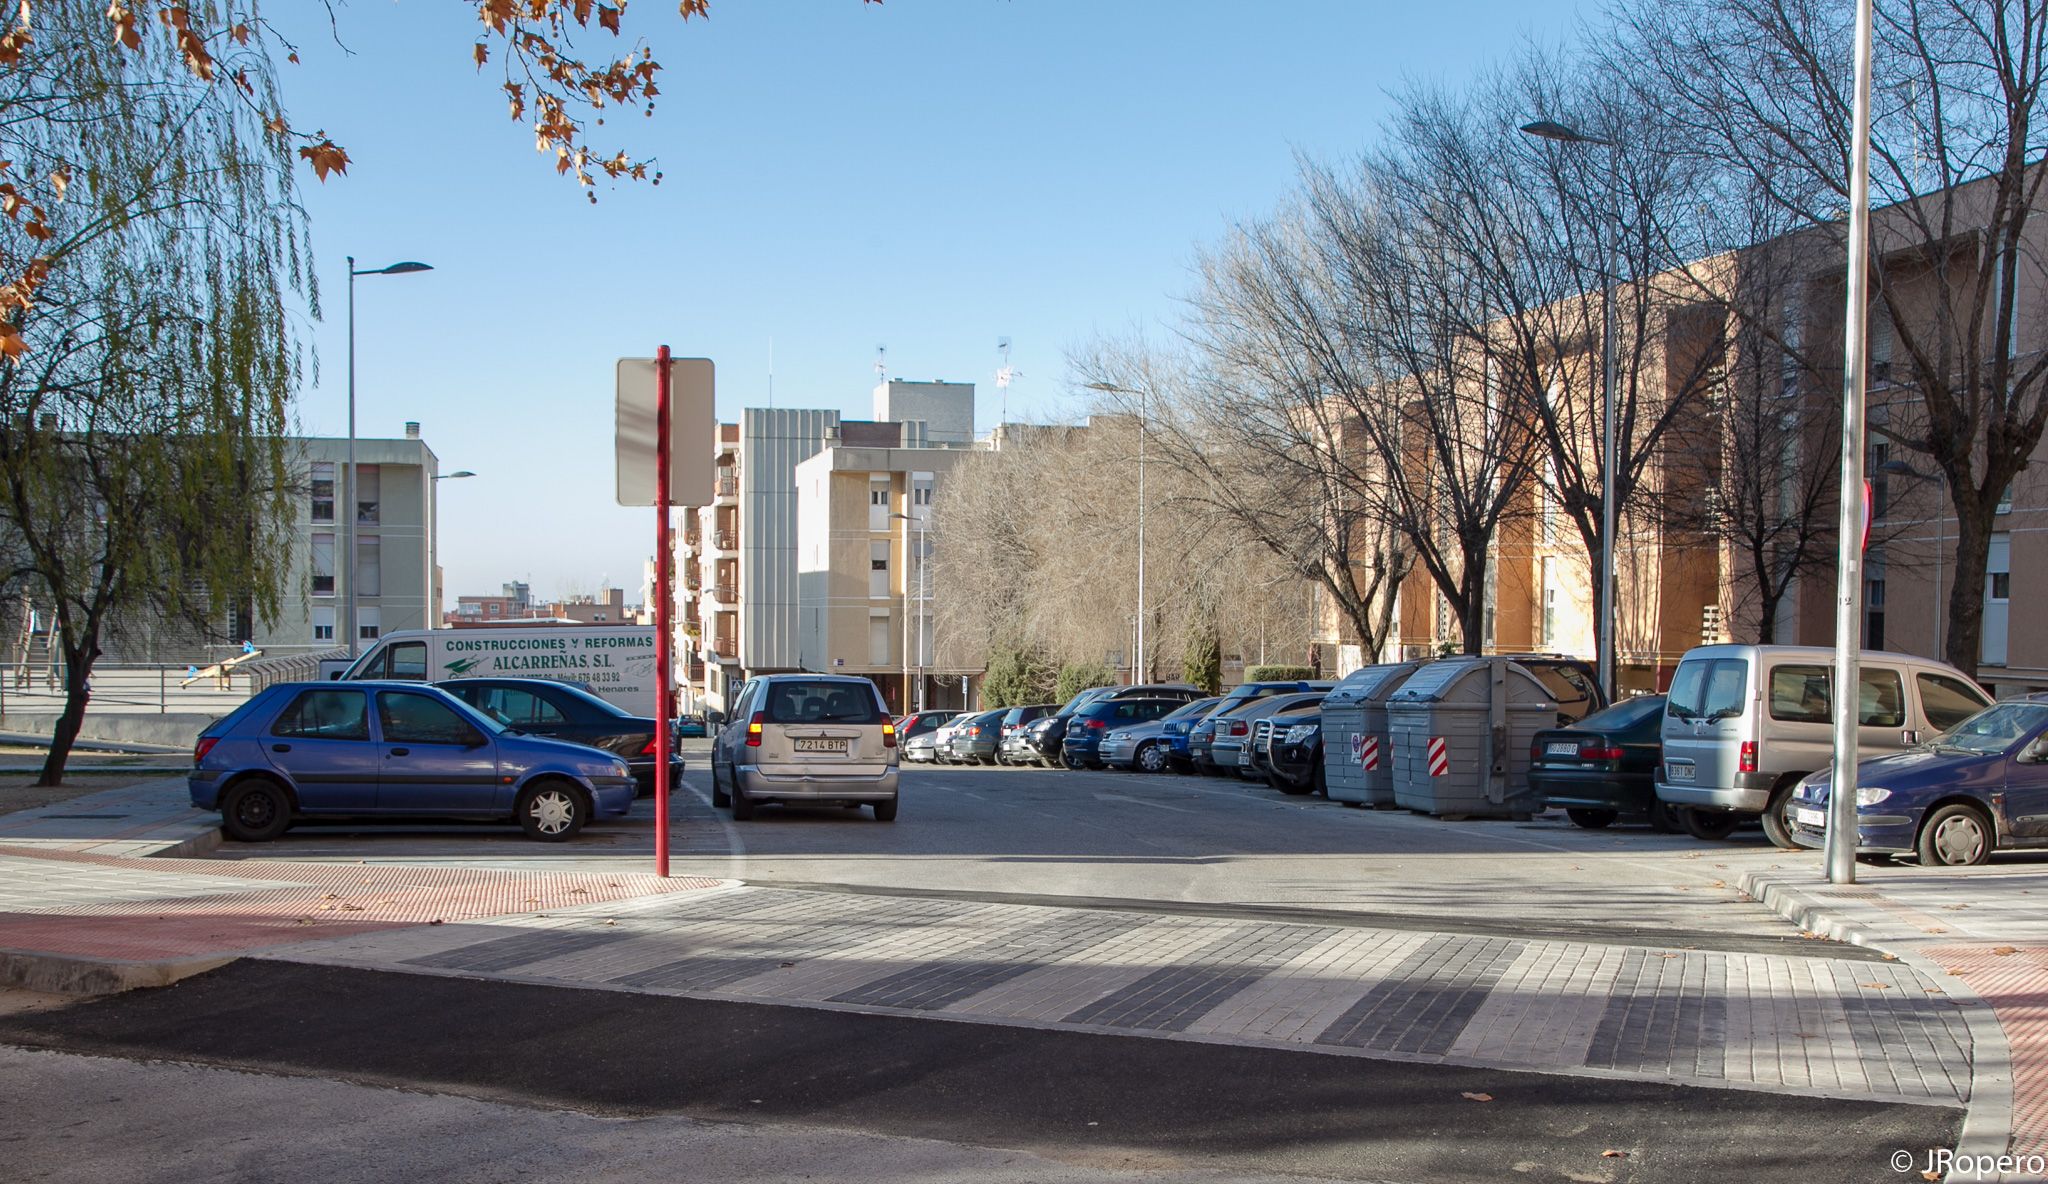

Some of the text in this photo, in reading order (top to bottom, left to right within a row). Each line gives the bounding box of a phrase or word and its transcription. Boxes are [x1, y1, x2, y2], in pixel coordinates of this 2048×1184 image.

[446, 636, 653, 651] CONSTRUCCIONES Y REFORMAS
[593, 653, 615, 668] S.L.
[578, 672, 591, 683] 676
[592, 672, 601, 683] 48
[602, 672, 611, 682] 33
[611, 671, 620, 682] 92
[800, 740, 846, 750] 7214 BTP
